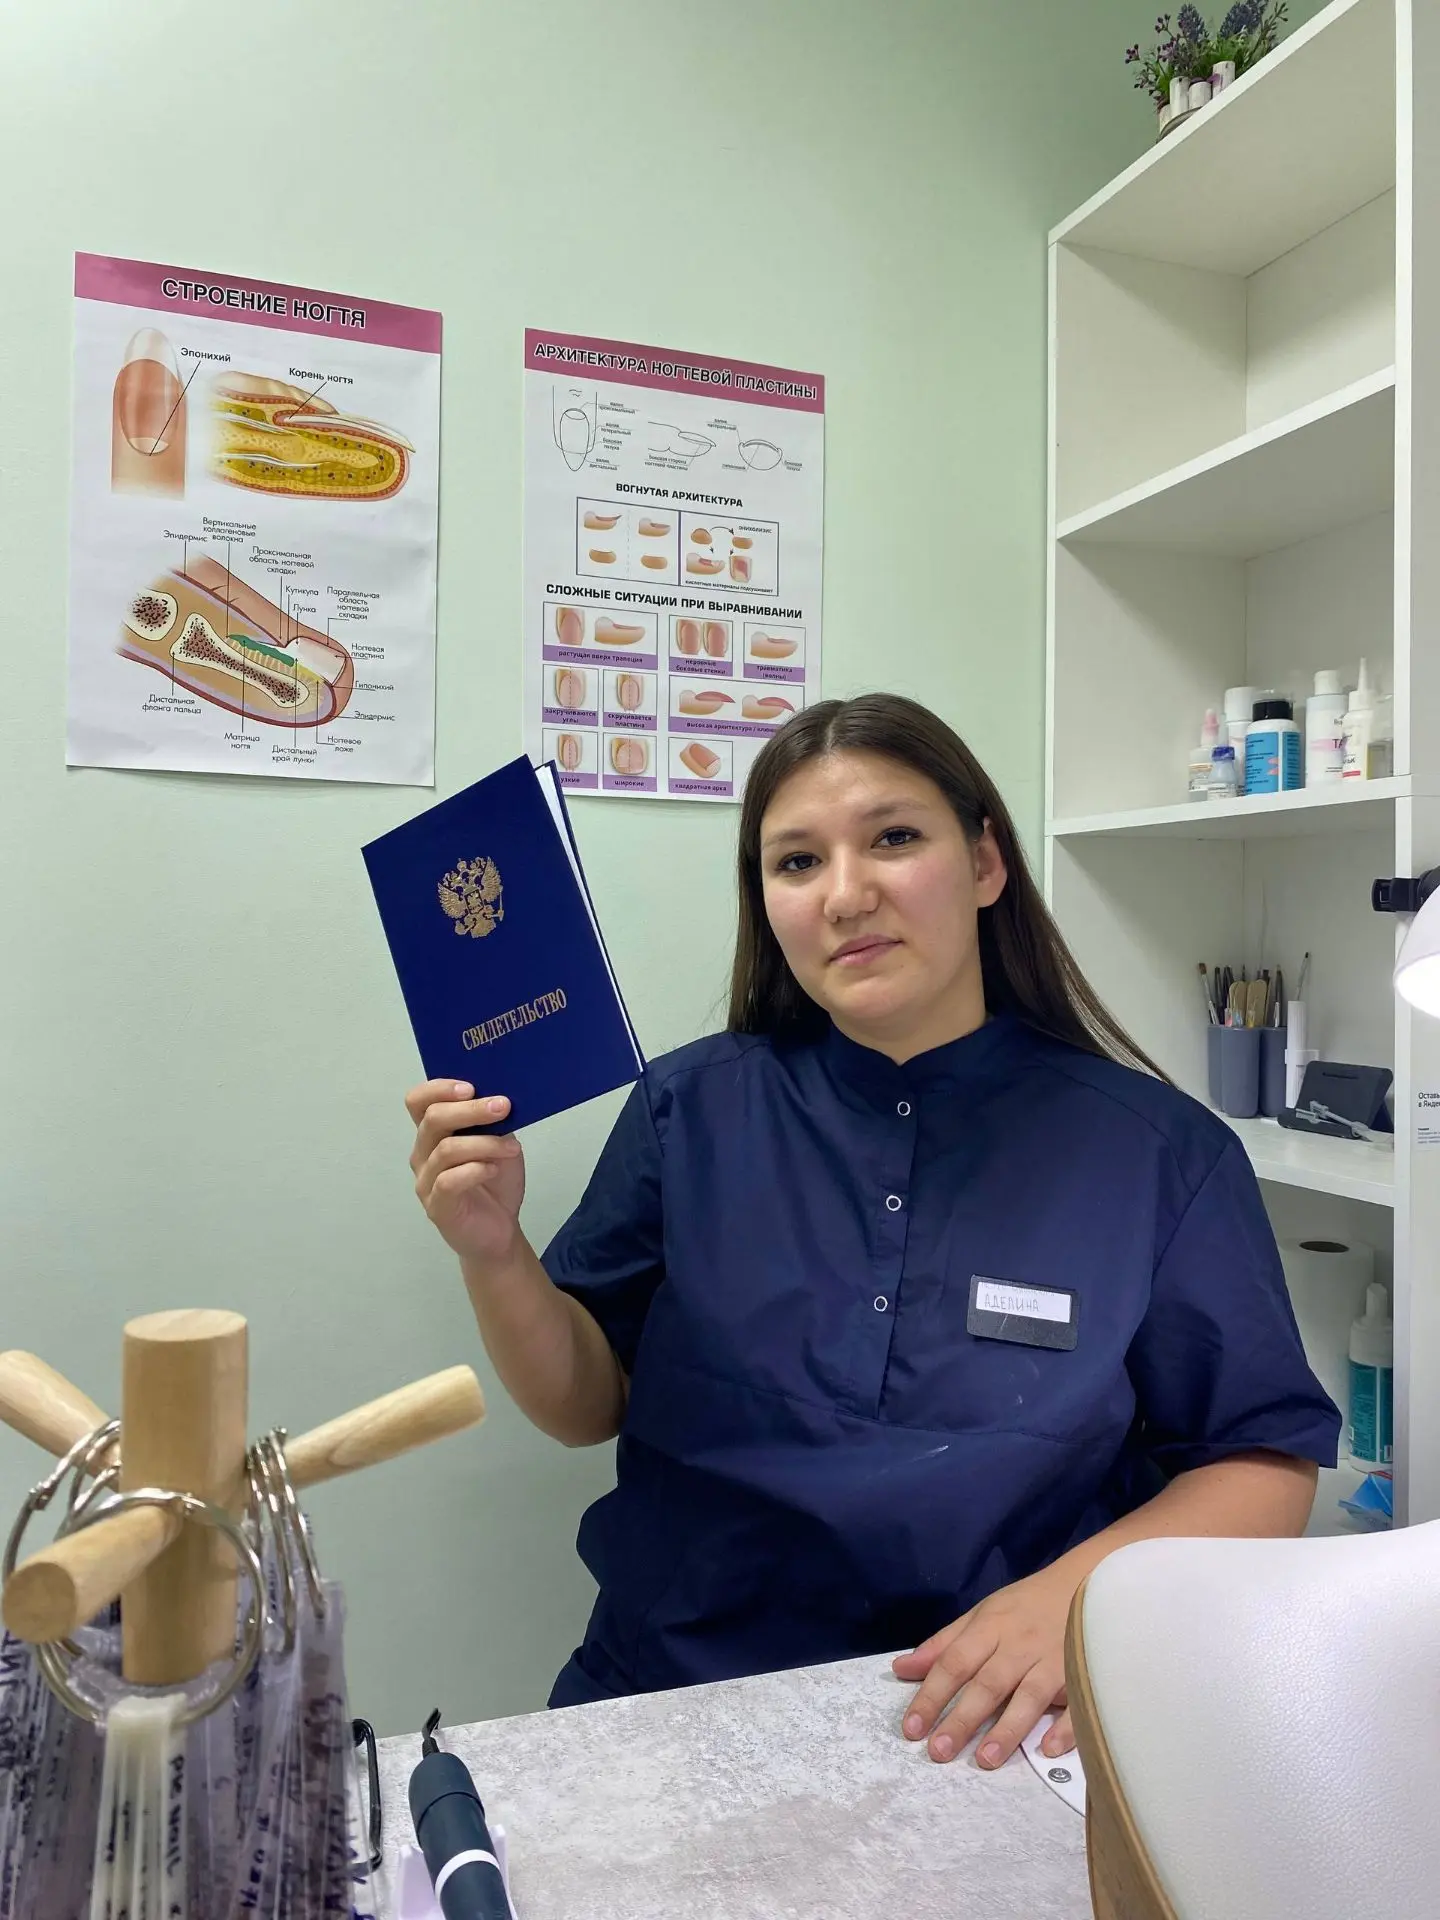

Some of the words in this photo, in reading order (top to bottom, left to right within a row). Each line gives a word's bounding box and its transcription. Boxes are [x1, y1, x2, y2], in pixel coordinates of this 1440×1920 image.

[162, 279, 287, 315] СТРОЕНИЕ
[293, 299, 365, 328] НОГТЯ
[181, 347, 231, 363] Эпонихий
[289, 367, 324, 383] Корень
[326, 373, 353, 385] ногтя
[534, 343, 647, 374] АРХИТЕКТУРА
[652, 361, 732, 387] НОГТЕВОЙ
[736, 376, 817, 400] ПЛАСТИНЫ
[616, 483, 669, 498] ВОГНУТАЯ
[672, 491, 743, 508] АРХИТЕКТУРА
[203, 517, 256, 530] Вертикальные
[163, 530, 208, 543] Эпидермис
[203, 526, 256, 538] коллагеновые
[212, 534, 244, 544] волокна
[252, 546, 312, 560] Проксимальная
[248, 555, 279, 566] область
[281, 559, 315, 569] ногтевой
[267, 566, 297, 576] складки
[285, 585, 319, 597] Кутикула
[338, 596, 368, 606] область
[546, 583, 611, 600] СЛОЖНЫЕ
[614, 590, 678, 607] СИТУАЦИИ
[681, 598, 705, 610] ПРИ
[708, 601, 802, 620] ВЫРАВНИВАНИИ
[293, 603, 316, 614] Лунка
[337, 604, 370, 613] ногтевой
[338, 612, 368, 621] складки
[351, 643, 385, 653] Ногтевая
[558, 651, 591, 660] растущая
[591, 653, 611, 661] вверх
[612, 655, 643, 664] трапеция
[675, 664, 703, 673] боковые
[685, 659, 717, 668] неровные
[756, 664, 793, 674] травматика
[355, 680, 394, 691] Гипонихий
[149, 694, 195, 705] Дистальная
[174, 706, 202, 715] пальца
[355, 710, 395, 722] Эпидермис
[544, 708, 596, 717] закручиваются
[607, 713, 652, 722] скручивается
[615, 721, 645, 729] пластина
[686, 721, 713, 730] высокая
[713, 723, 752, 733] архитектура
[224, 732, 260, 743] Матрица
[327, 735, 362, 746] Ногтевое
[231, 742, 251, 750] ногтя
[272, 745, 318, 756] Дистальный
[271, 754, 291, 764] край
[293, 757, 315, 765] лунки
[560, 776, 581, 784] узкие
[614, 780, 645, 788] широкие
[675, 783, 712, 791] квадратная
[462, 988, 567, 1051] СВИДЕТЕЛЬСТВО
[984, 1293, 1040, 1312] АДЕЛИНА
